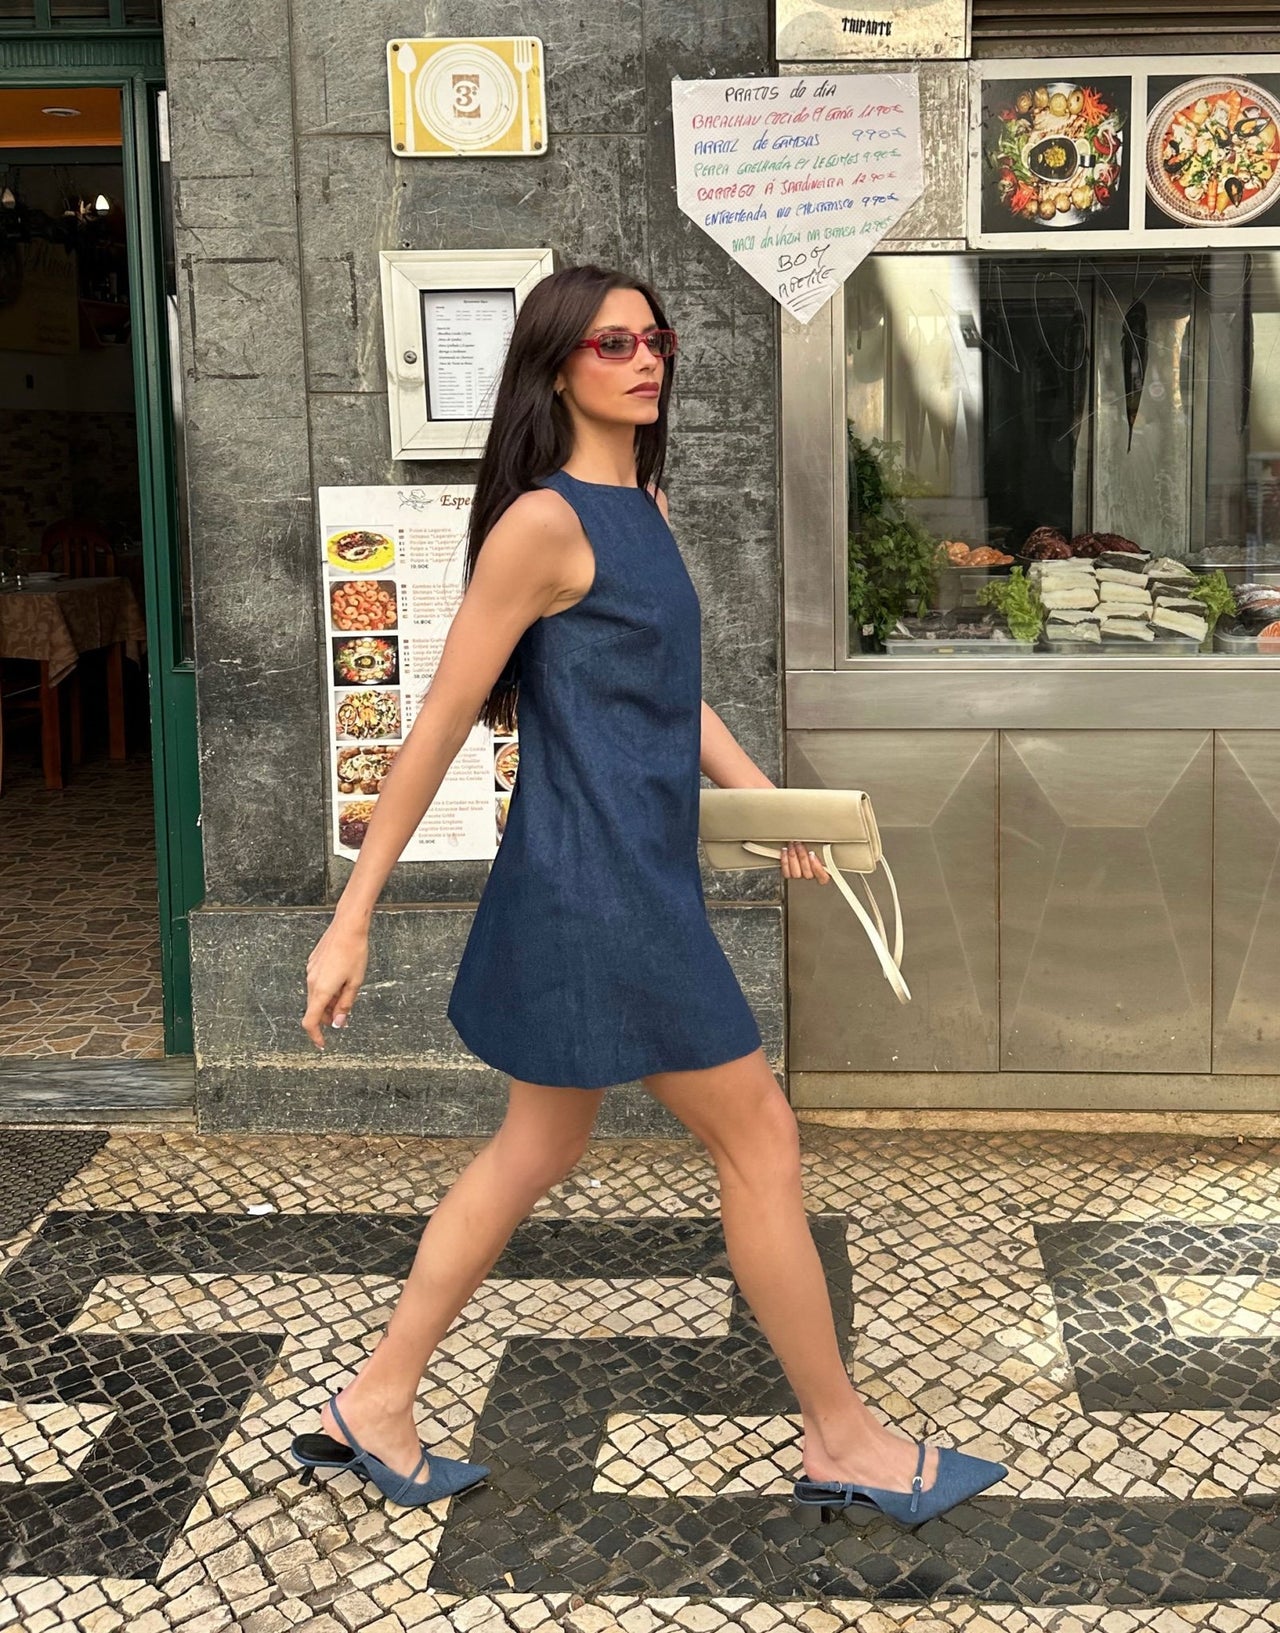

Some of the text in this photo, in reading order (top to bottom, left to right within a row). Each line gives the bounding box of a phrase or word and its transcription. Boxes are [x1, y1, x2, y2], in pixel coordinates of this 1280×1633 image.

[841, 16, 893, 37] TRIPARTE
[725, 85, 779, 102] PRATOS
[692, 113, 763, 129] BACALHAU
[694, 139, 739, 156] ARROZ
[772, 134, 821, 150] GAMBAS
[694, 162, 730, 178] PERCA
[812, 154, 859, 170] LEGUMES
[776, 206, 791, 219] NO
